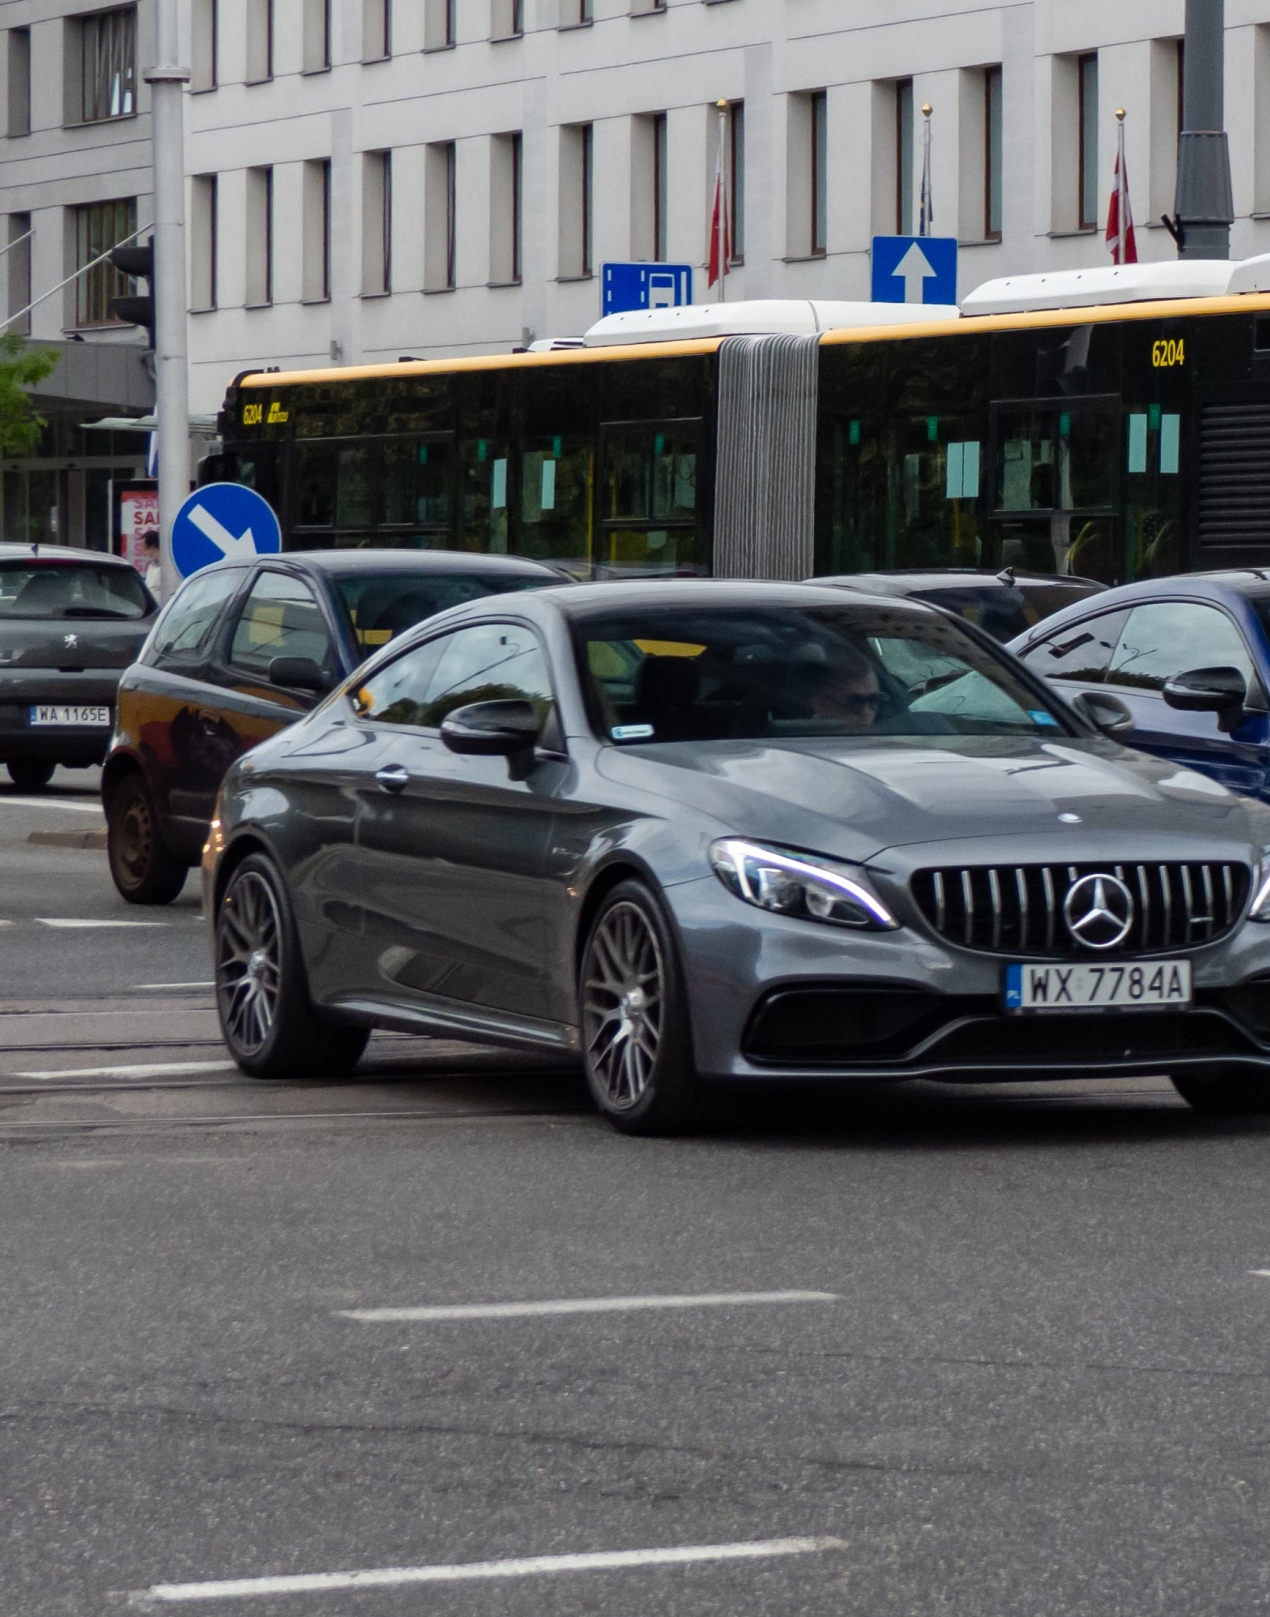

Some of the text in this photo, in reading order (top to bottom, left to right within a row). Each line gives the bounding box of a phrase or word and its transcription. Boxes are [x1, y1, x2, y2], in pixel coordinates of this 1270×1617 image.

[1152, 339, 1185, 367] 6204
[40, 707, 58, 721] WA
[64, 707, 106, 721] 1165E
[1030, 965, 1184, 1002] WX 7784A
